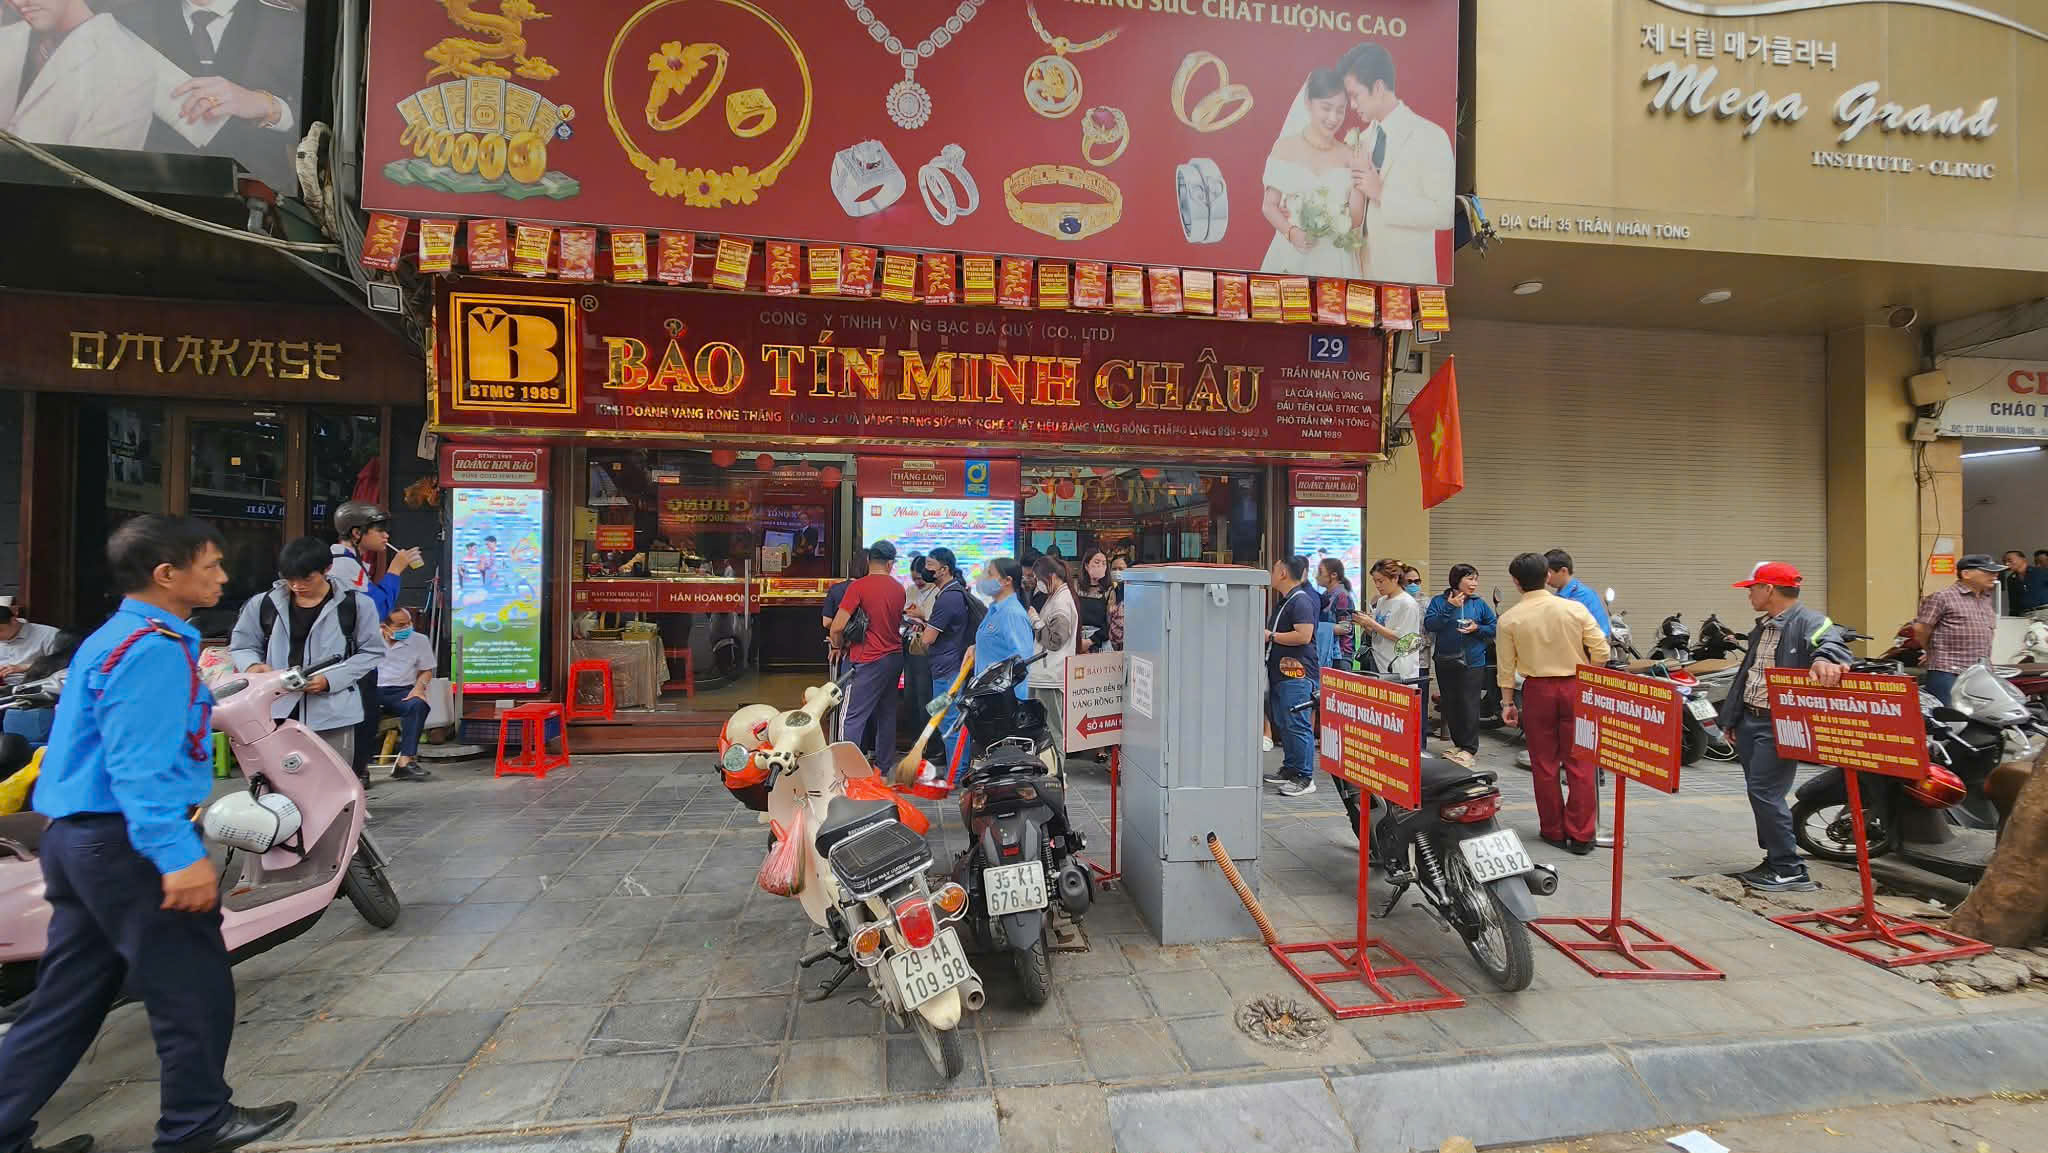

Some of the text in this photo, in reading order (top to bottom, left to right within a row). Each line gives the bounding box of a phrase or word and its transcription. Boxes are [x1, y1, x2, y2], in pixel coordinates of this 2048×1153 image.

[1271, 3, 1351, 32] LƯỢNG
[1357, 15, 1407, 38] CAO
[1647, 61, 1999, 142] Mega Grand
[1812, 151, 1913, 172] INSTITUTE
[1930, 160, 1995, 179] CLINIC
[1500, 215, 1522, 231] ĐỊA
[1557, 217, 1571, 231] 35
[1616, 219, 1649, 237] NHÂN
[1655, 222, 1690, 240] TÔNG
[840, 315, 882, 329] TNHH
[888, 316, 932, 331] VNG
[70, 330, 343, 381] OMAKASE
[1316, 338, 1344, 358] 29
[602, 318, 1265, 413] BẢO TÍN MINH CHÂU
[470, 384, 560, 400] BTMC 1989
[626, 404, 669, 418] DOANH
[922, 473, 945, 481] LONG
[1336, 699, 1356, 723] NGHỊ
[1357, 706, 1382, 727] NHÂN
[1383, 712, 1404, 735] DÂN
[1594, 693, 1615, 715] NGHỊ
[1616, 699, 1643, 718] NHÂN
[1643, 705, 1666, 725] DÂN
[1796, 695, 1828, 712] NGHỊ
[1829, 697, 1868, 714] NHÂN
[1870, 699, 1902, 717] DÂN
[1104, 719, 1118, 728] MAI
[993, 865, 1034, 890] 35-K1
[1474, 851, 1530, 878] 939.82
[991, 886, 1043, 912] 676.43
[900, 936, 952, 979] 29-AA
[905, 957, 966, 1004] 109.98
